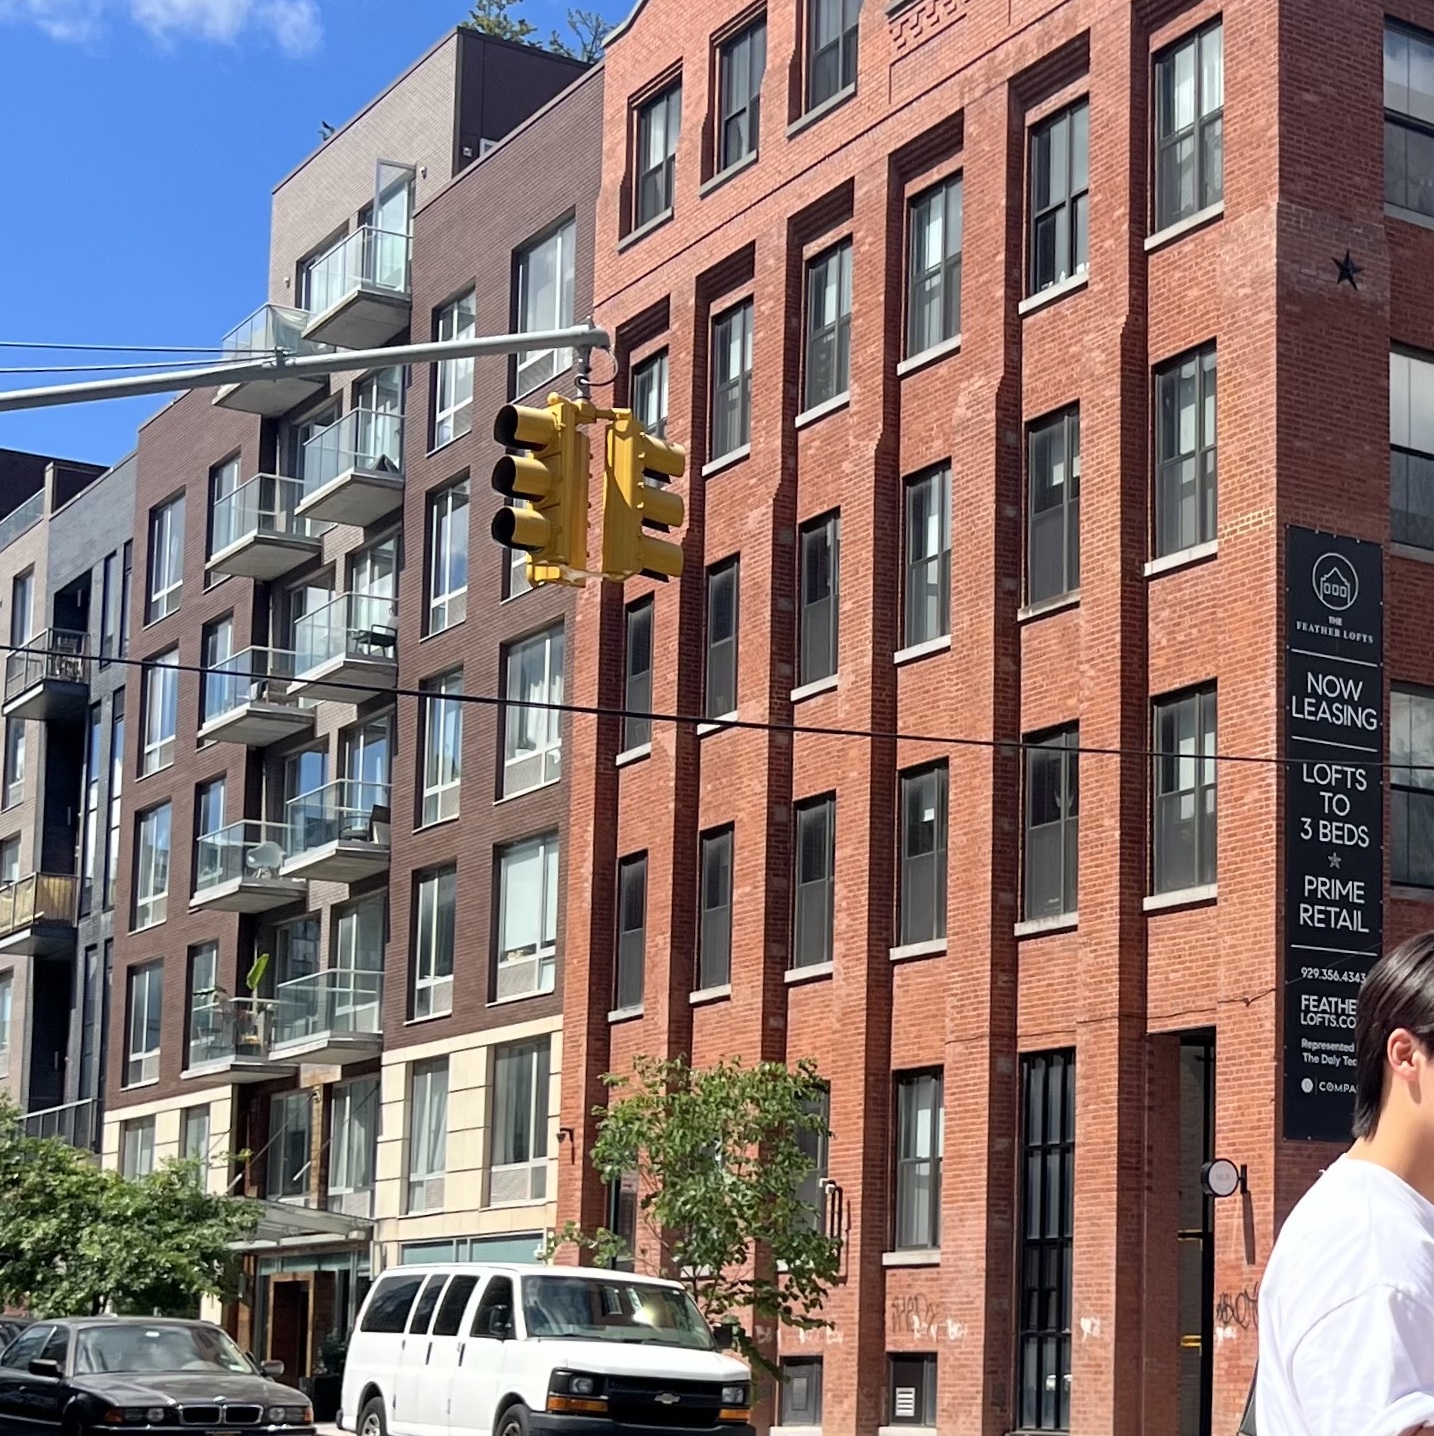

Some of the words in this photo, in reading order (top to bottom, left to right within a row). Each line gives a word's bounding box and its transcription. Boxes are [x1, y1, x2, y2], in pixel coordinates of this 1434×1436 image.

[1296, 620, 1341, 638] FEATHER
[1343, 629, 1374, 645] LOFTS
[1328, 615, 1342, 626] THE
[1307, 671, 1363, 701] NOW
[1292, 695, 1378, 730] LEASING
[1302, 763, 1368, 791] LOFTS
[1319, 791, 1350, 816] TO
[1300, 817, 1312, 840] 3
[1319, 820, 1370, 848] BEDS
[1304, 875, 1365, 904] PRIME
[1299, 903, 1370, 933] RETAIL
[1301, 966, 1366, 984] 929.356.4343
[1301, 994, 1357, 1015] FEATHE
[1301, 1012, 1357, 1029] LOFTS.CO
[1301, 1038, 1355, 1052] Represented
[1302, 1052, 1320, 1063] The
[1319, 1081, 1358, 1094] COMPA
